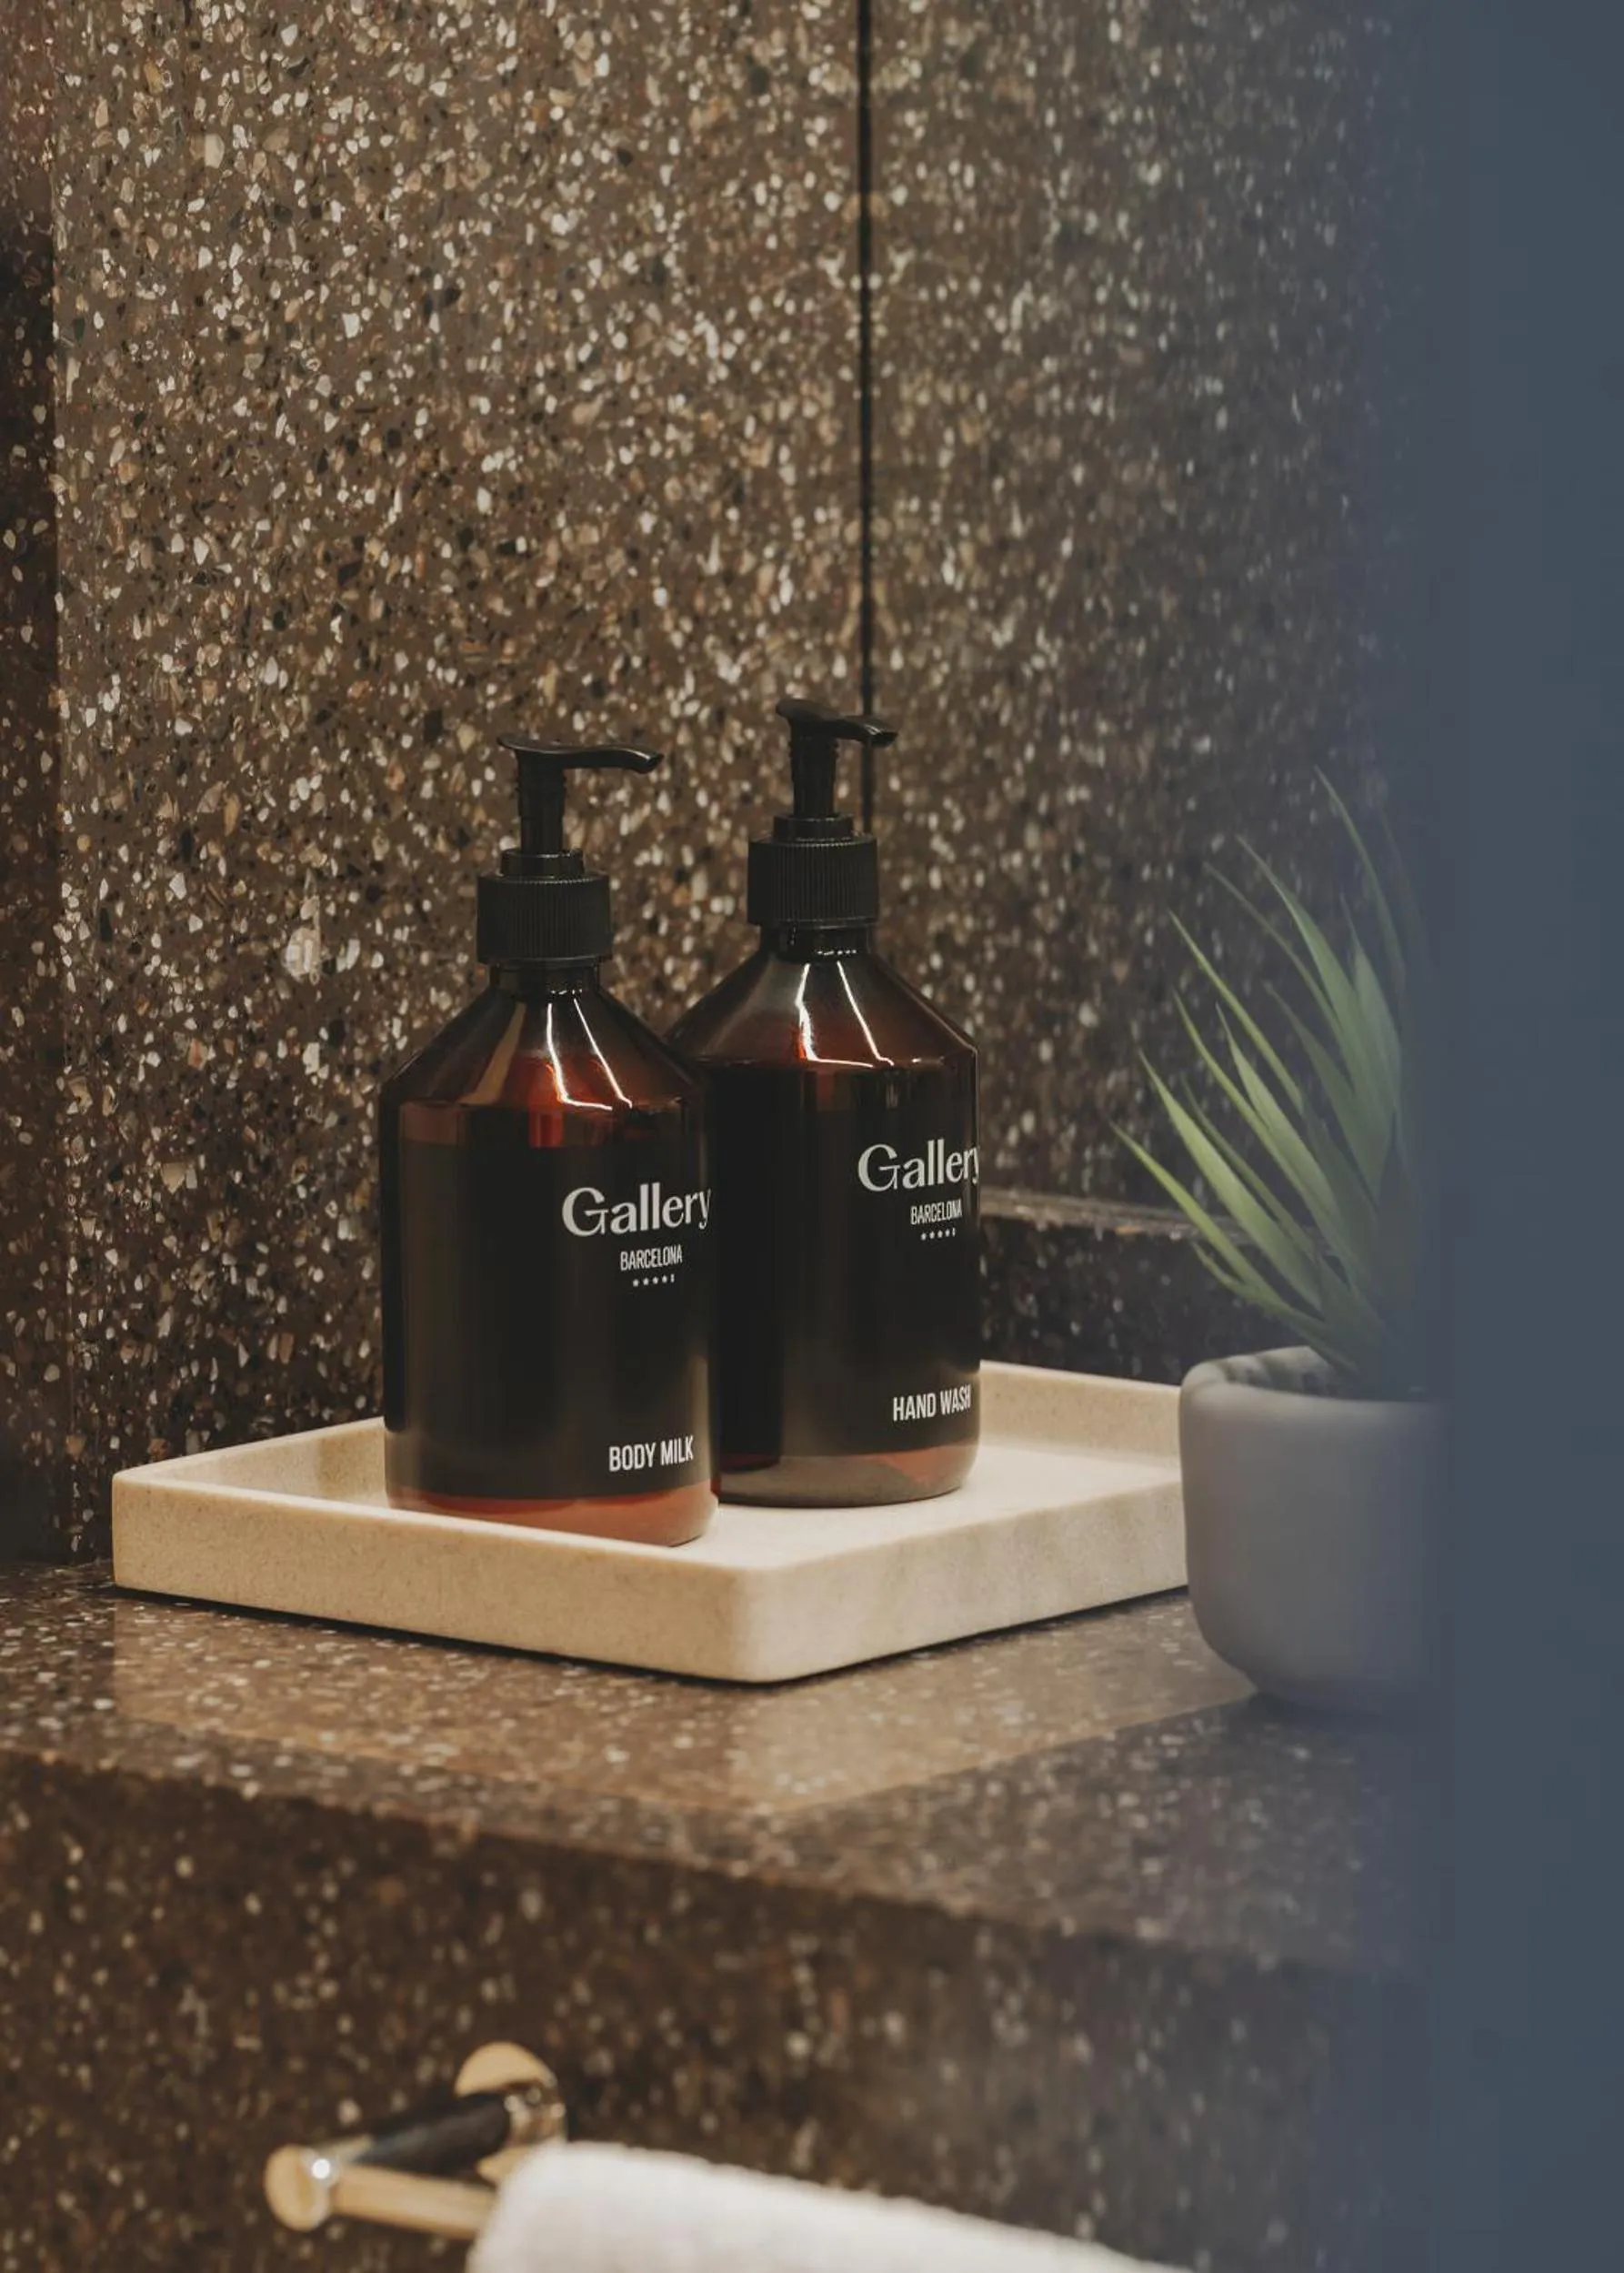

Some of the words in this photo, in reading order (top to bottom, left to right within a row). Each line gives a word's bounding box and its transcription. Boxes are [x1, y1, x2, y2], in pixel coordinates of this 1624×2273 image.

[562, 1182, 711, 1236] Gallery
[910, 1199, 962, 1225] BARCELONA
[620, 1244, 682, 1271] BARCELONA
[893, 1393, 937, 1422] HAND
[939, 1383, 971, 1415] WASH
[609, 1442, 656, 1472] BODY
[660, 1435, 694, 1465] MILK
